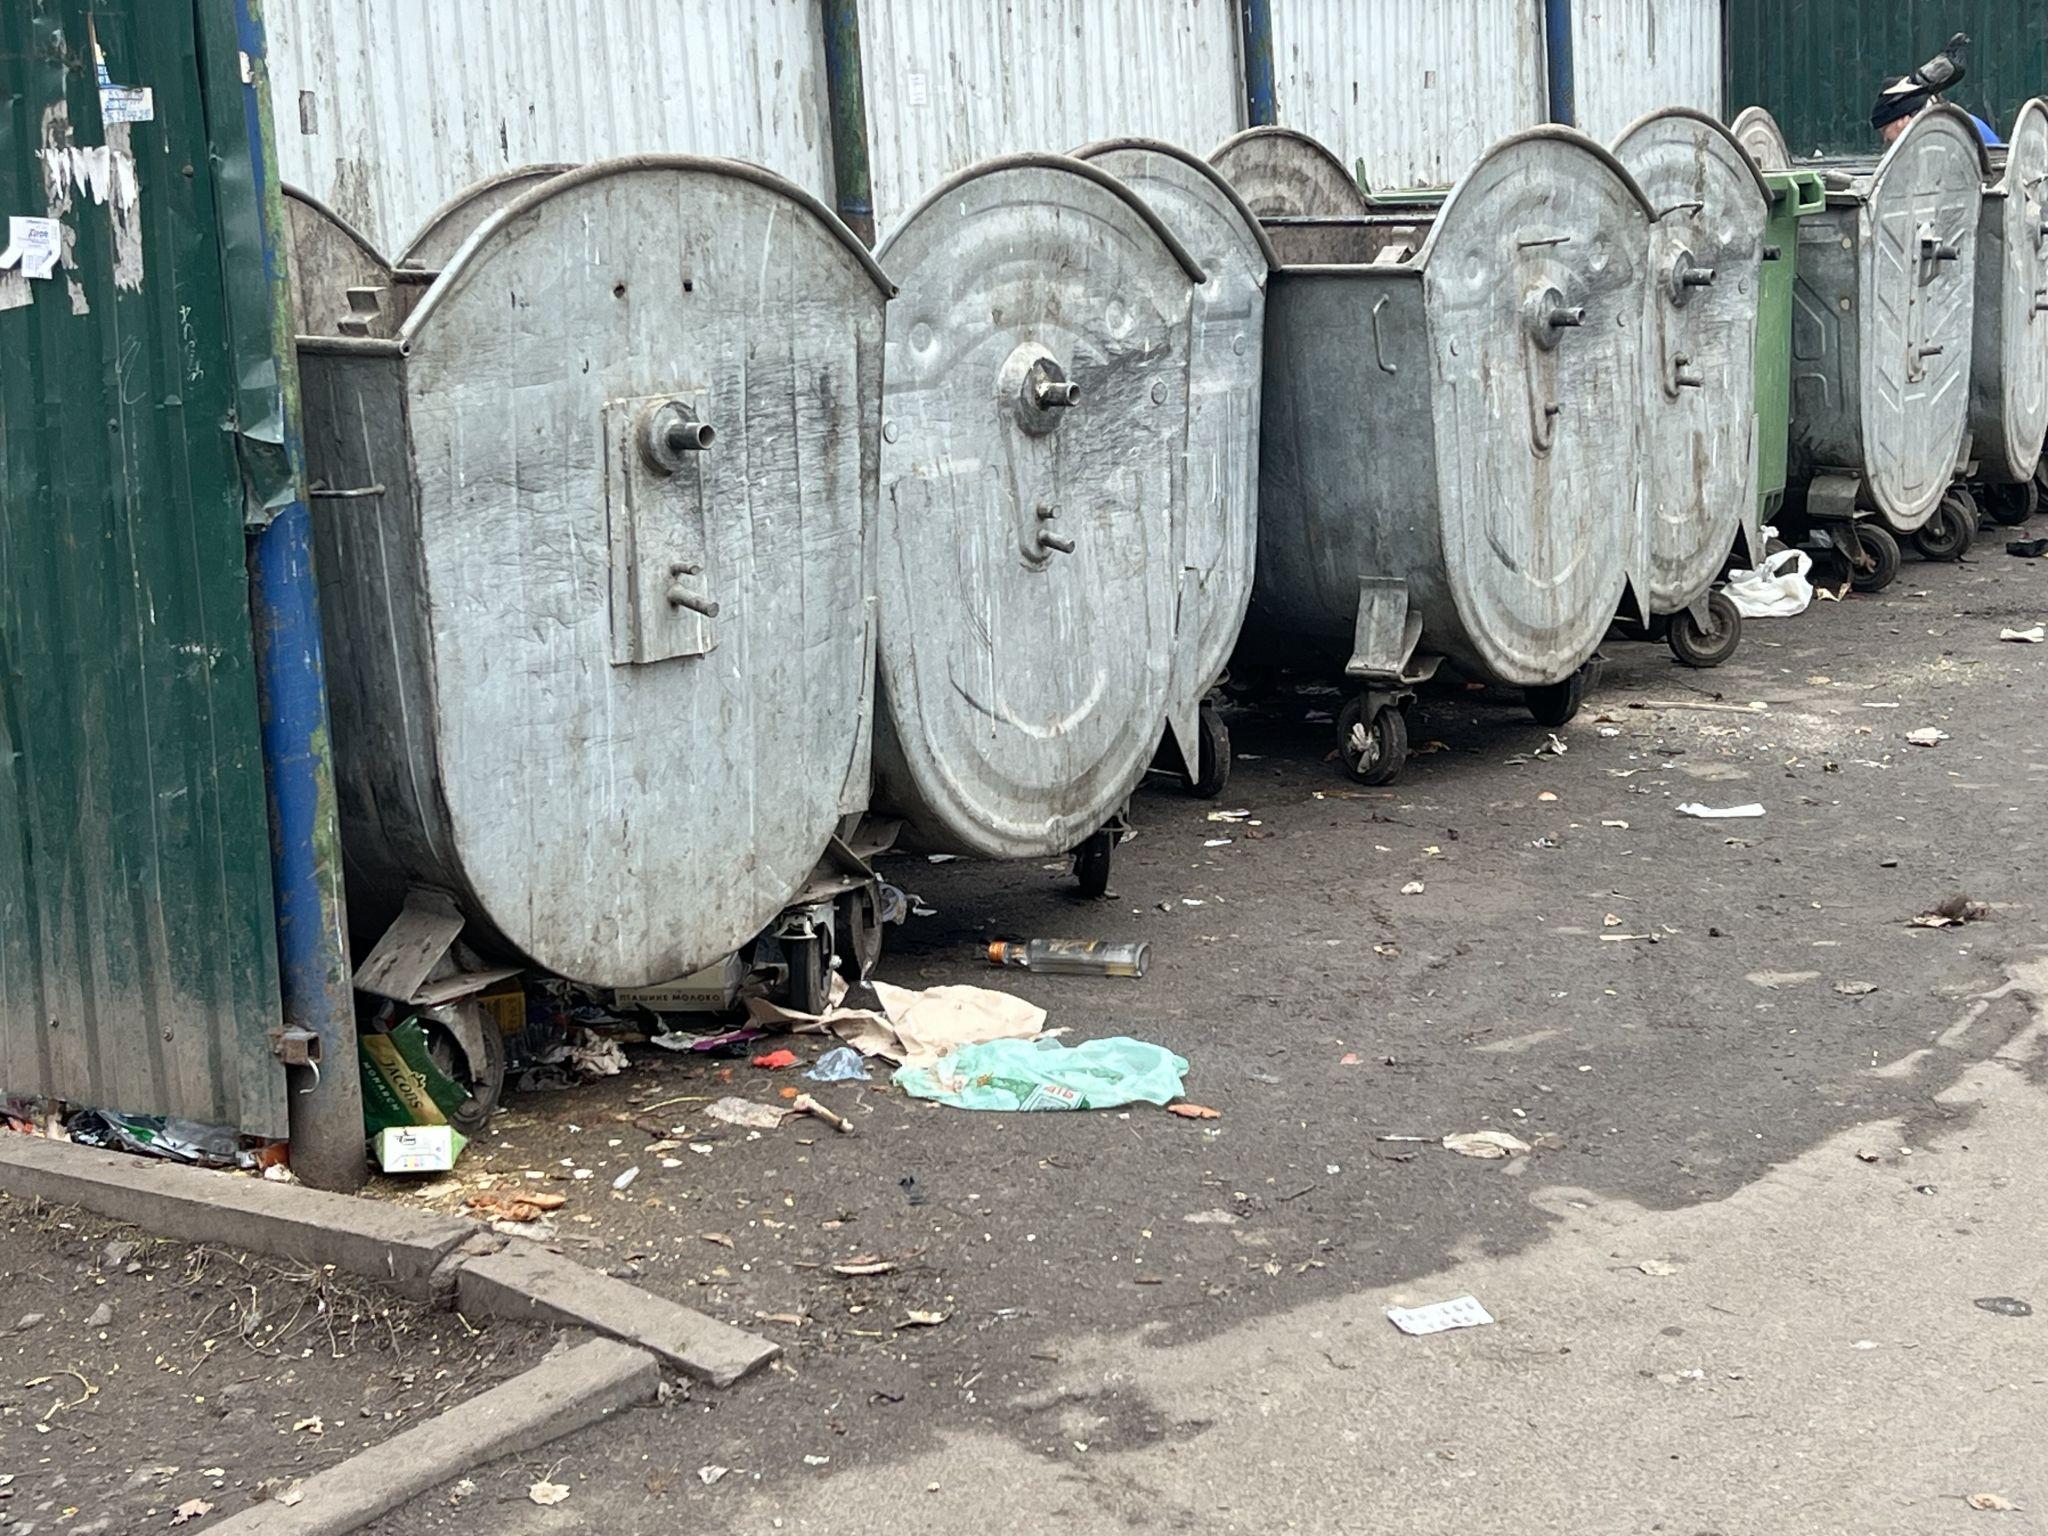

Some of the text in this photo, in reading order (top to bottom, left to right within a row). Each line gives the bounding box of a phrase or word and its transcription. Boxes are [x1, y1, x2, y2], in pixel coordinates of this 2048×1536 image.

[672, 994, 721, 1002] МОЛОКО
[362, 1061, 401, 1112] MONARCH
[380, 1060, 424, 1109] JACOBS
